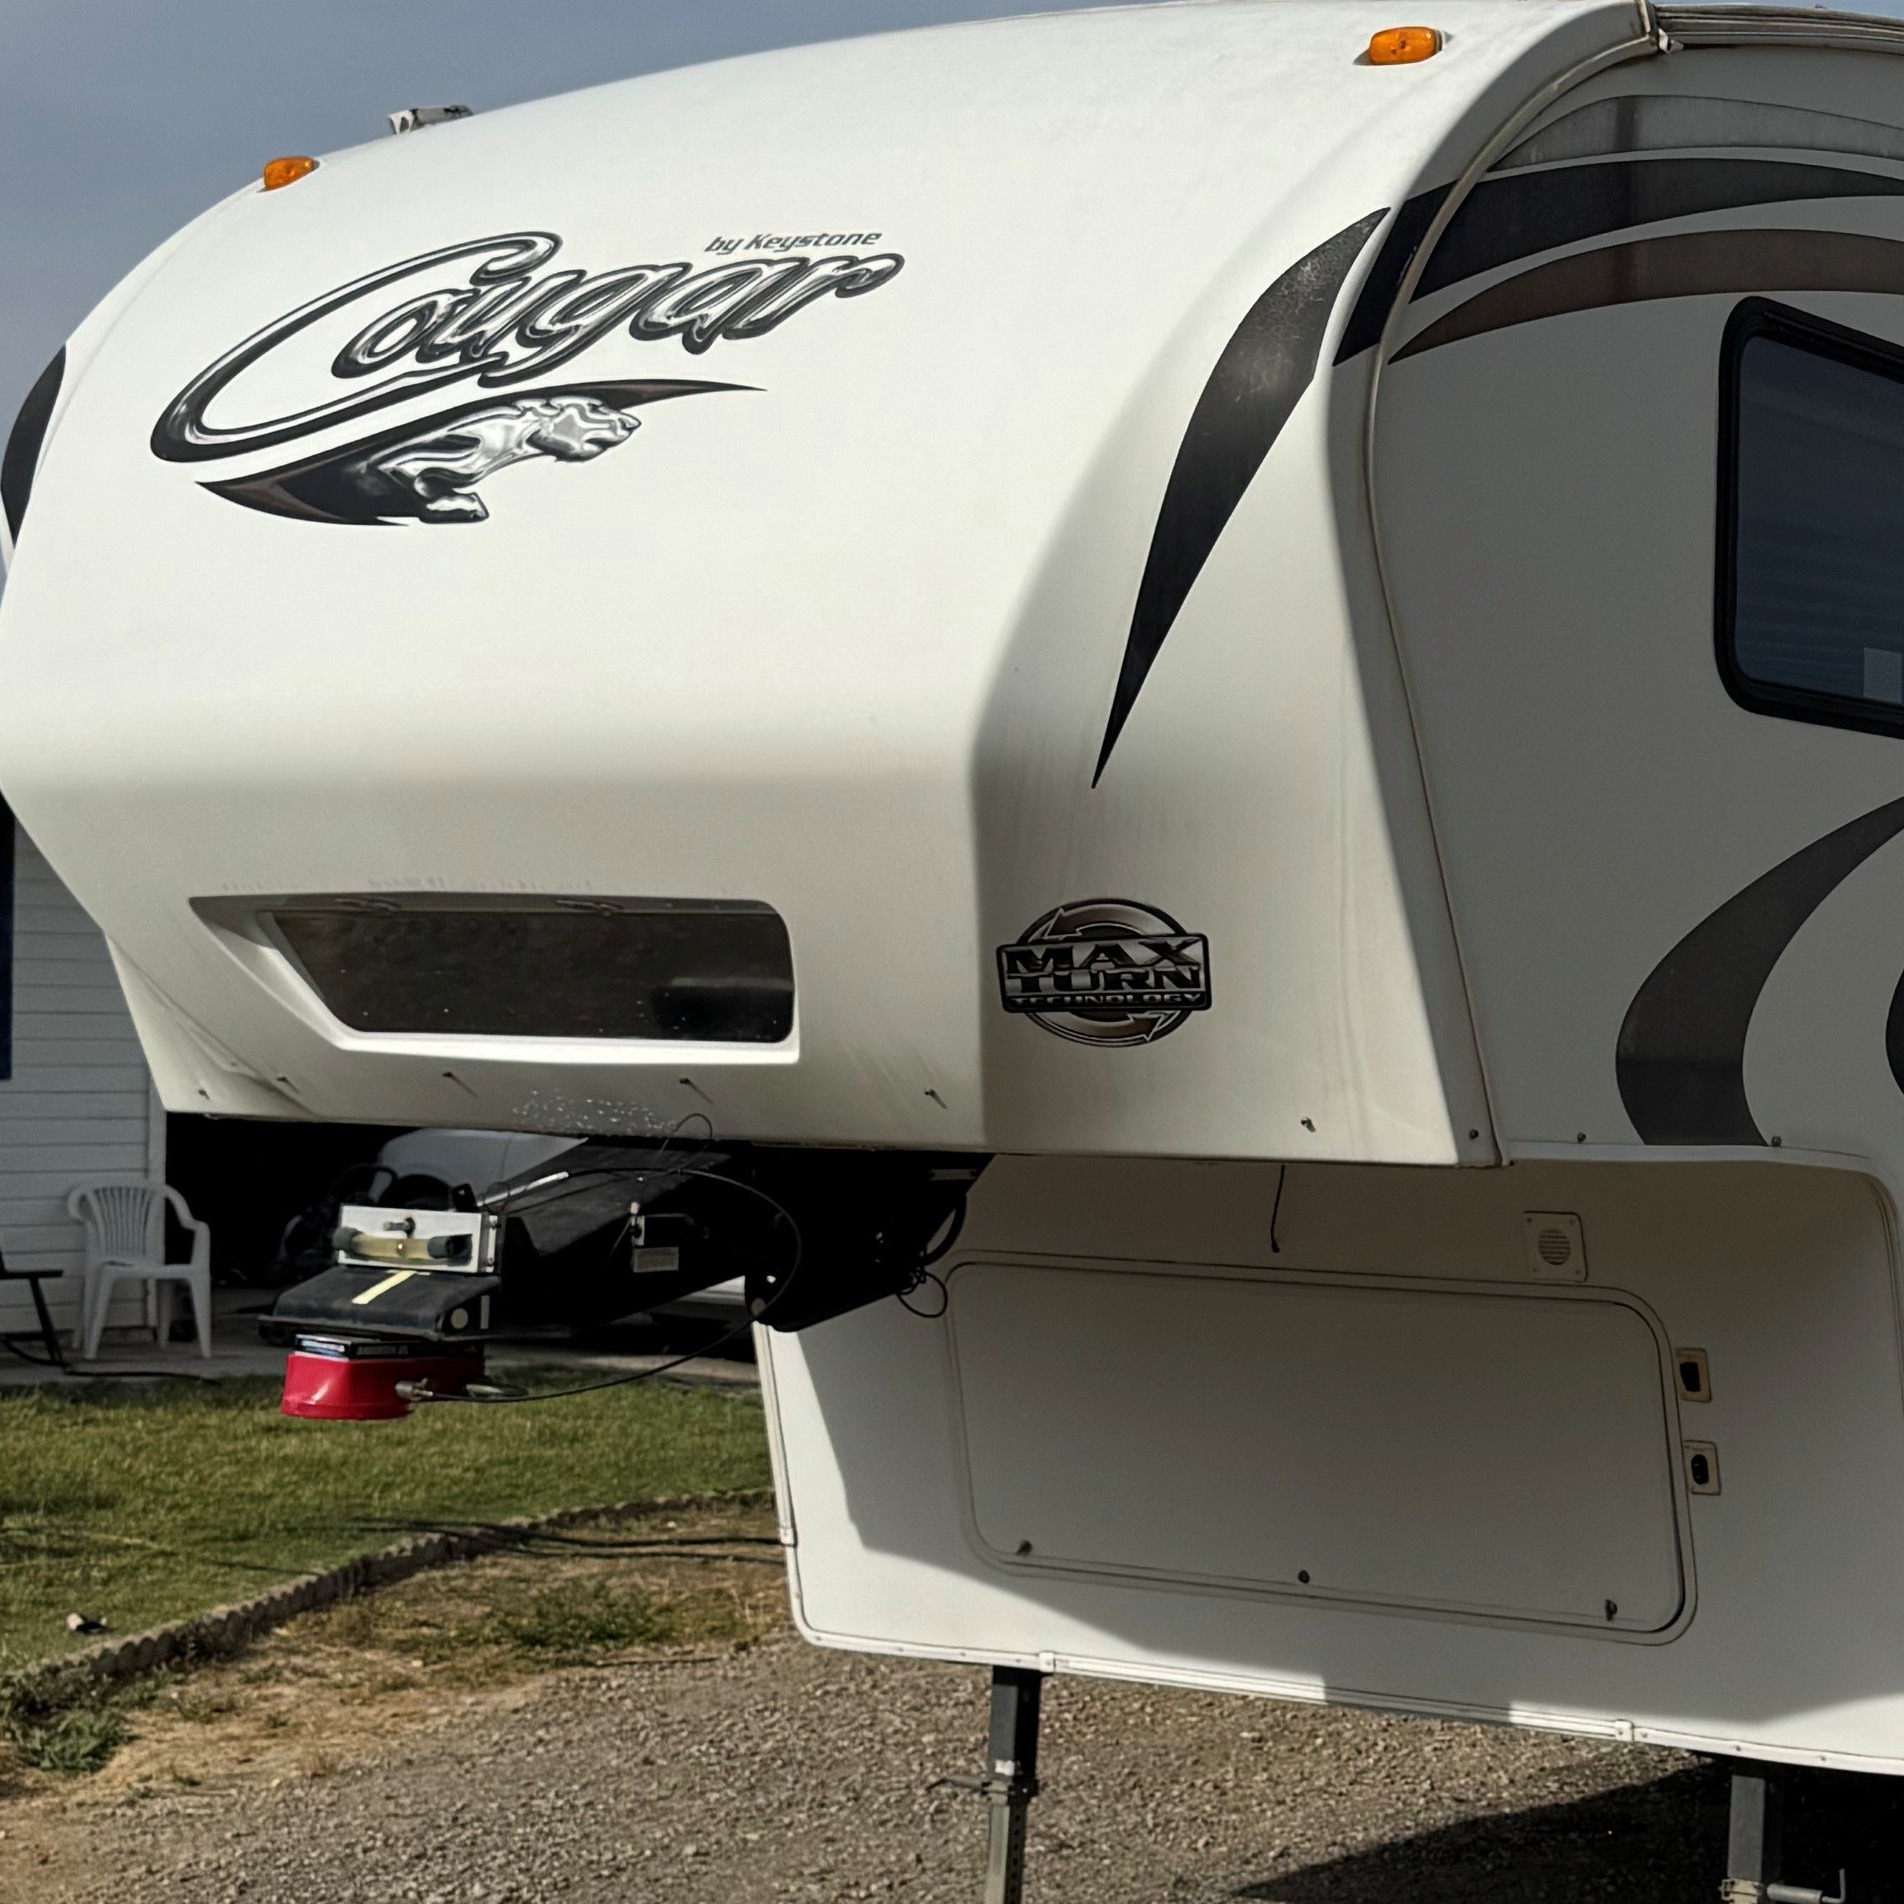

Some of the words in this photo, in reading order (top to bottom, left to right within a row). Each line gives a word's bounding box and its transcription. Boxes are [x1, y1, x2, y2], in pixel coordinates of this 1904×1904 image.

[704, 236, 744, 255] by
[744, 232, 882, 252] Keystone
[150, 232, 905, 463] Cougar
[1005, 938, 1201, 974] MAX
[1007, 966, 1200, 993] TURN
[1010, 994, 1200, 1006] TECHNOLOGY
